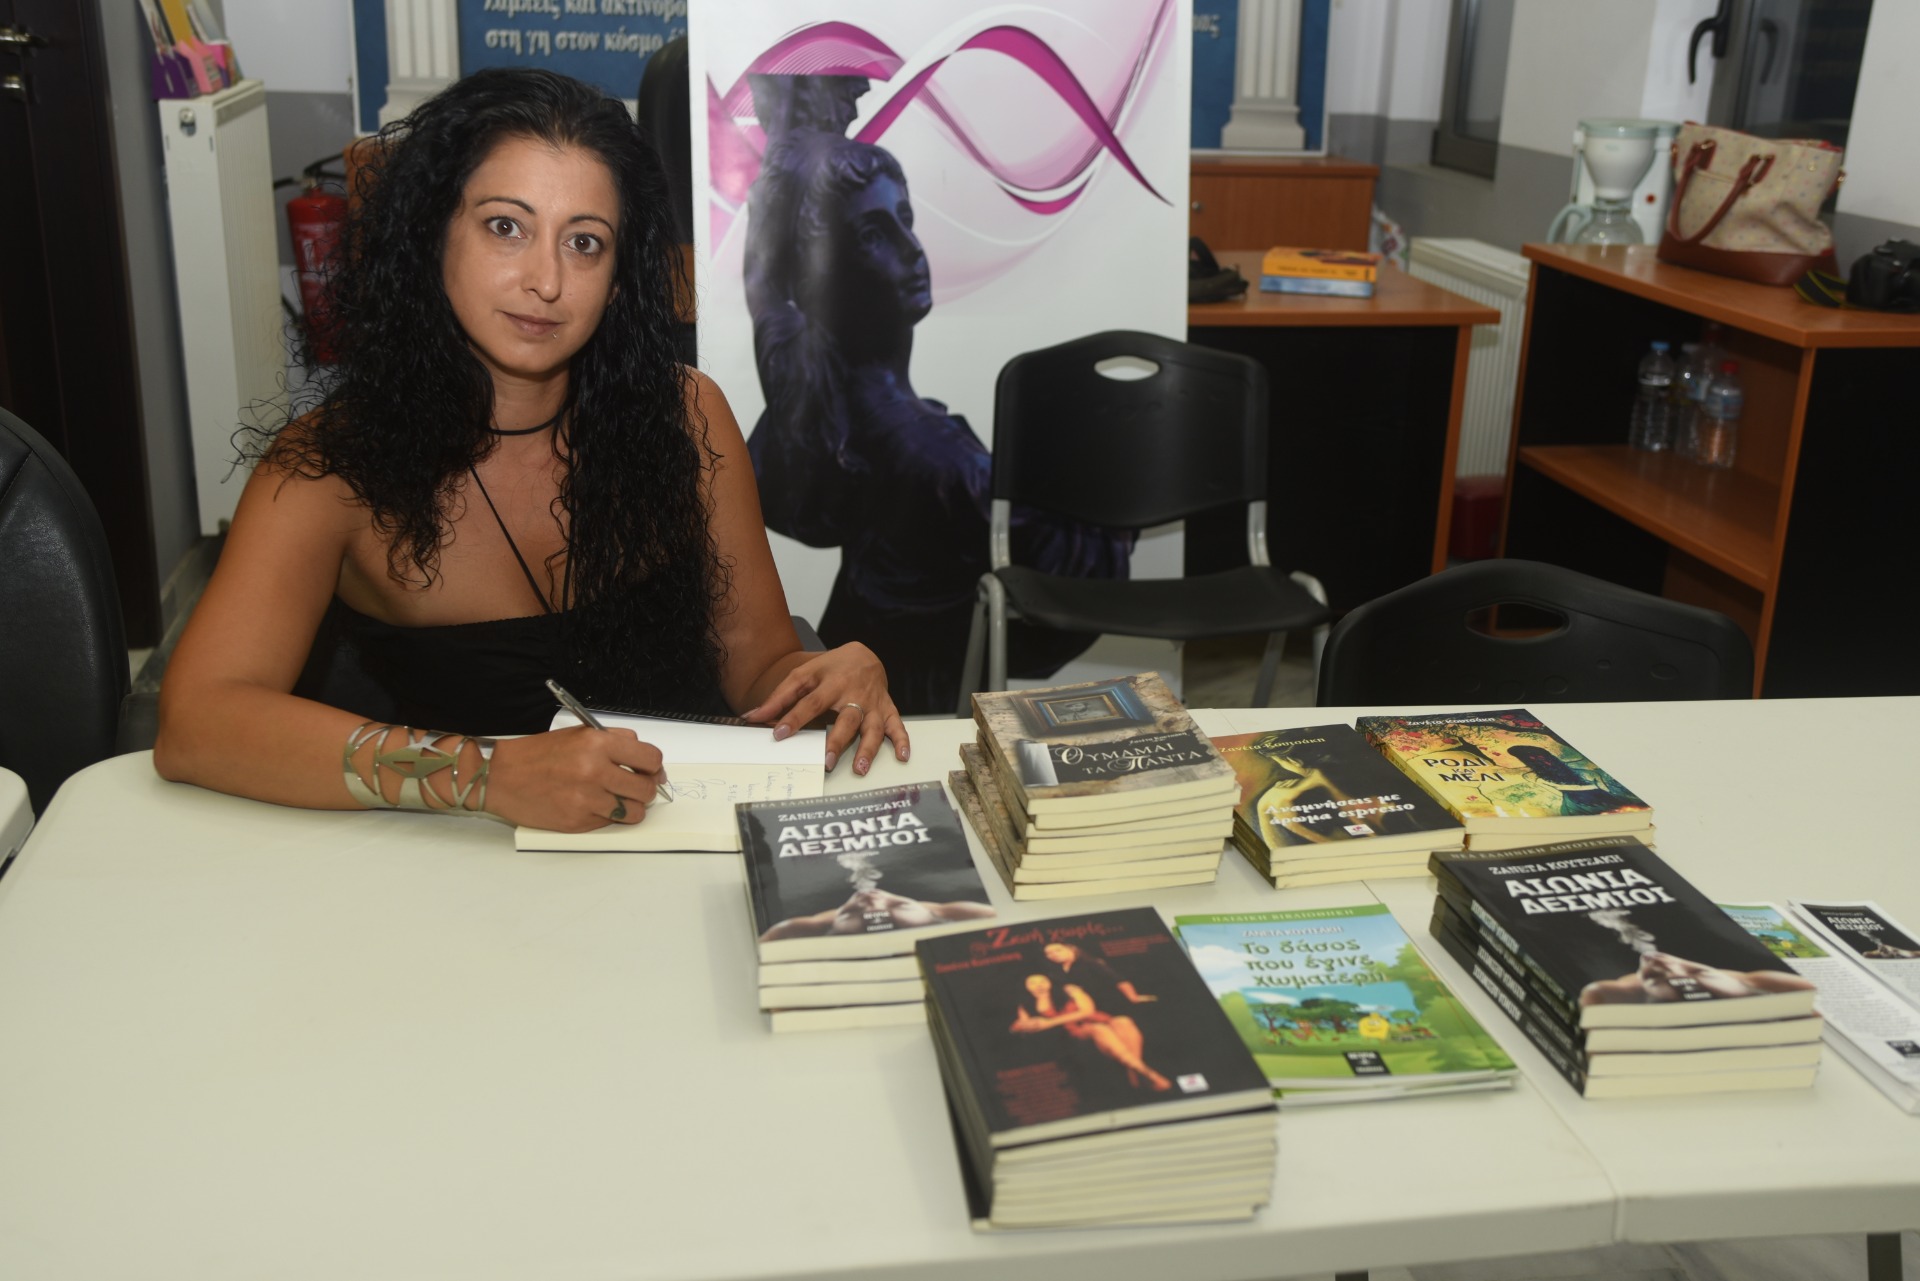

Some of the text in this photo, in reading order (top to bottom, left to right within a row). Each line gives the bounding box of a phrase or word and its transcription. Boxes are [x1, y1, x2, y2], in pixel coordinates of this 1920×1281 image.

[485, 30, 522, 55] στη
[526, 31, 550, 55] γη
[555, 32, 599, 49] στον
[604, 26, 663, 58] κόσμο
[1438, 773, 1507, 783] ΜΕΛΙ
[777, 809, 835, 823] ΖΑΝΕΤΑ
[777, 811, 925, 844] ΑΙΩΝΙΑ
[778, 827, 932, 859] ΔΕΣΜΙΟΙ
[1488, 863, 1548, 876] ΖΑΝΕΤΑ
[1504, 867, 1655, 899] ΑΙΩΝΙΑ
[1519, 885, 1677, 915] ΔΕΣΜΙΟΙ
[1240, 938, 1361, 955] Το δάσος
[1244, 959, 1294, 971] που
